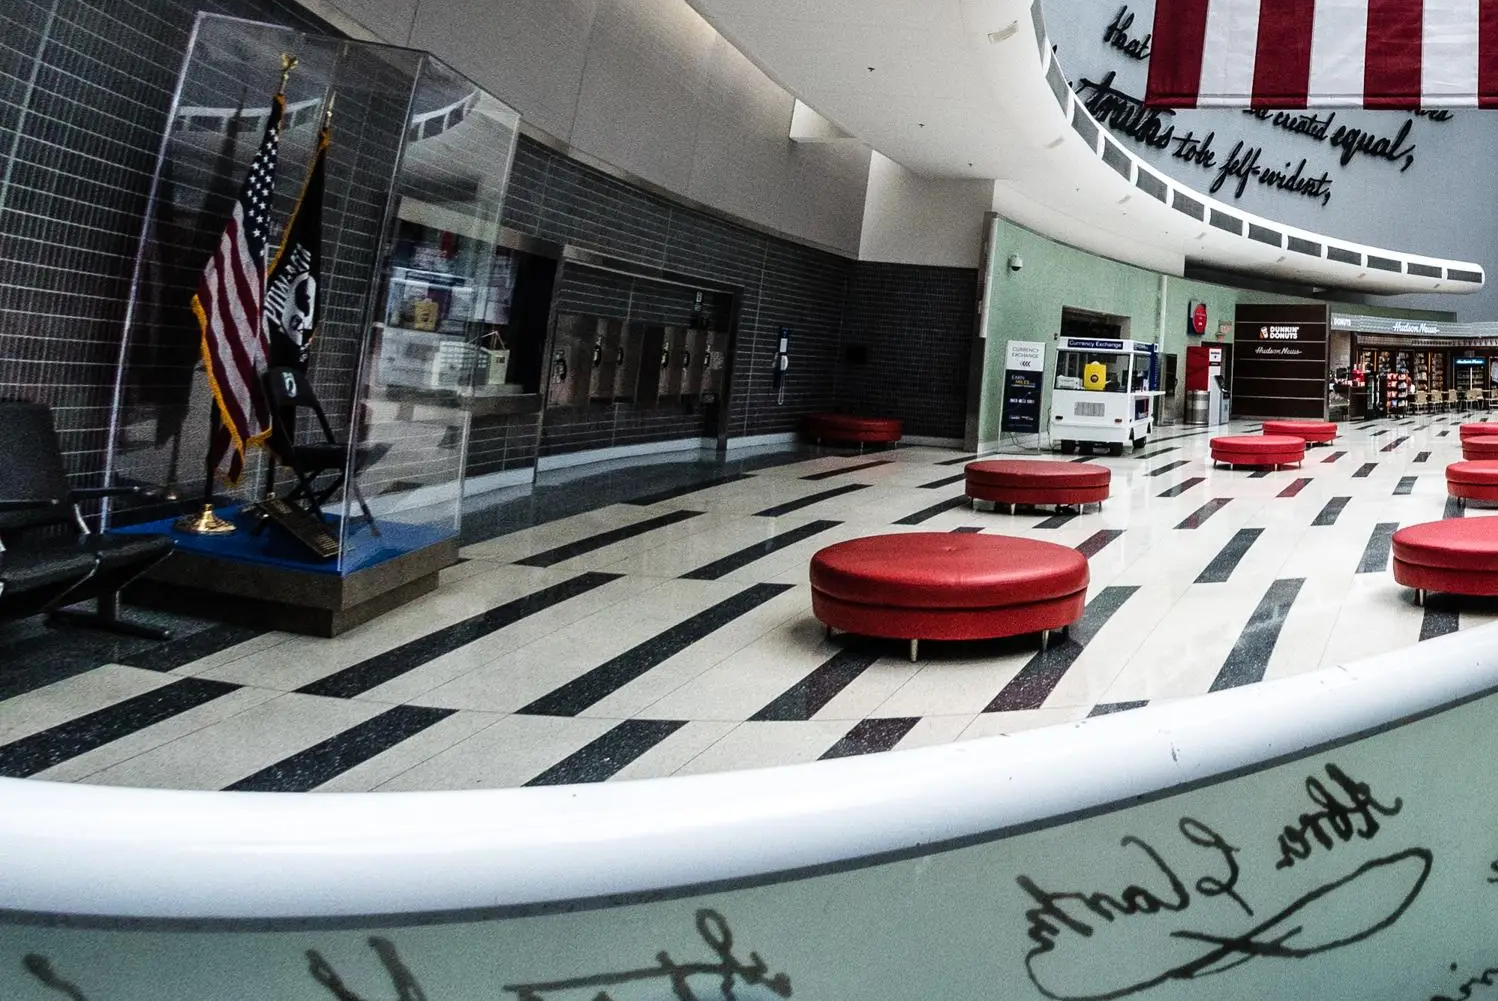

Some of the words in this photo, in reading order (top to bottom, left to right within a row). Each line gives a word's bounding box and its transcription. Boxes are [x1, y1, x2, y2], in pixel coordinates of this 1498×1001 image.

[1330, 119, 1416, 172] equal,
[1393, 321, 1419, 332] Hudson
[1068, 340, 1095, 348] Currency
[1095, 340, 1122, 348] Exchange
[1255, 346, 1281, 354] Hudson
[1280, 347, 1302, 355] News
